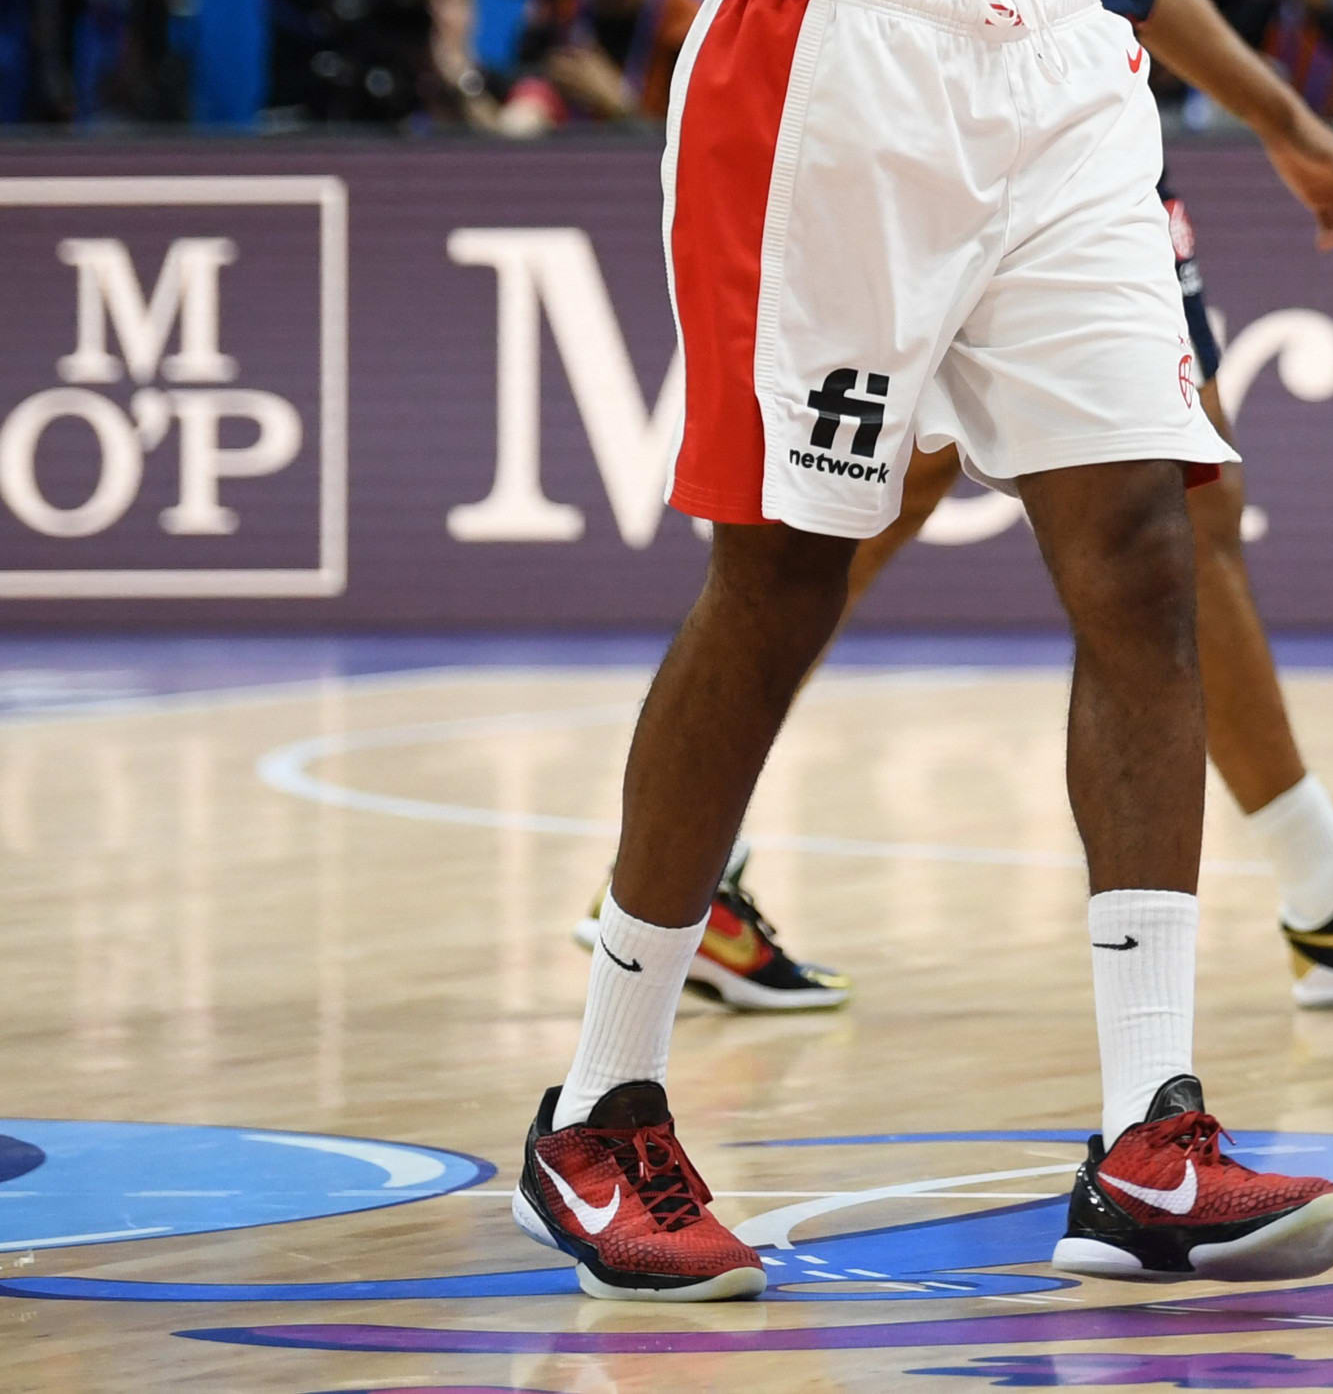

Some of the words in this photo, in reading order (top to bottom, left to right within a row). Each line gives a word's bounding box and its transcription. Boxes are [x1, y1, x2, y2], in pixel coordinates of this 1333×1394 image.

[58, 237, 238, 384] M
[806, 367, 890, 459] fi
[788, 448, 891, 484] network
